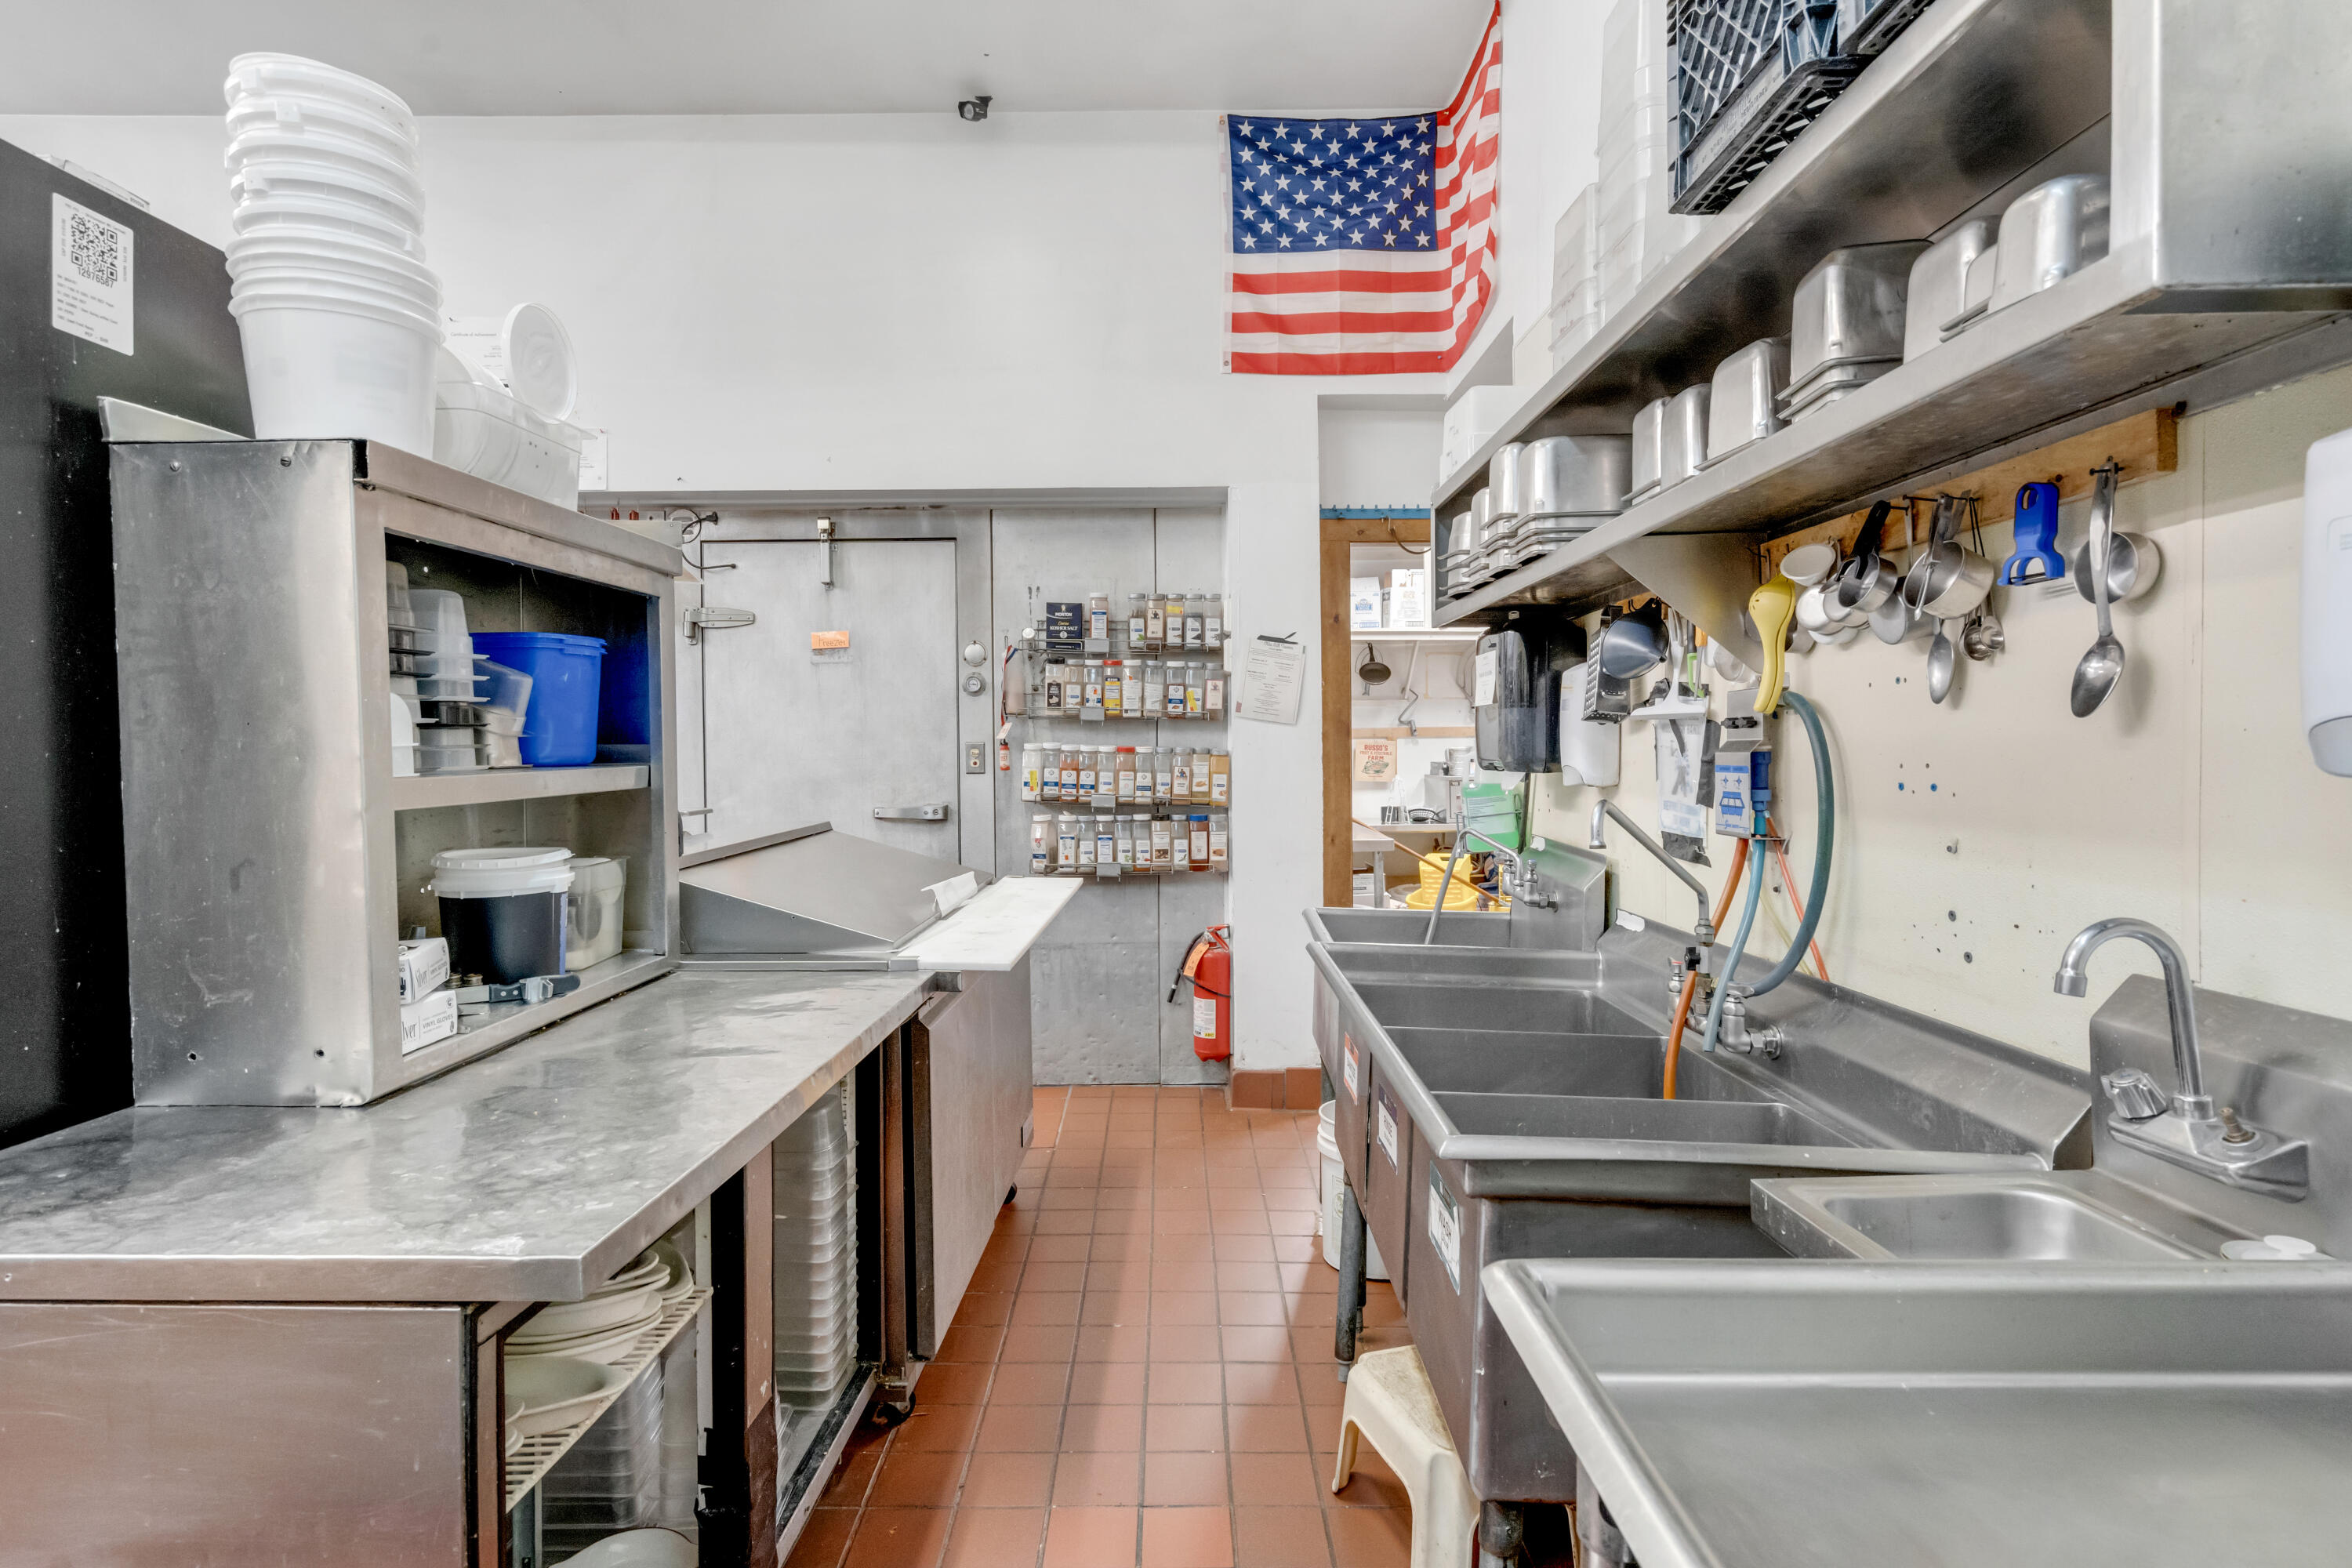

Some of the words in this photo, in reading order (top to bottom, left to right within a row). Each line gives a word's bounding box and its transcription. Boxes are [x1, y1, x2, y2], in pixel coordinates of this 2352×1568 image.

[77, 267, 114, 288] 12976587
[401, 1021, 417, 1041] lver
[422, 1019, 436, 1029] VINYL
[437, 1014, 454, 1024] GLOVES
[1439, 1210, 1452, 1243] WASH
